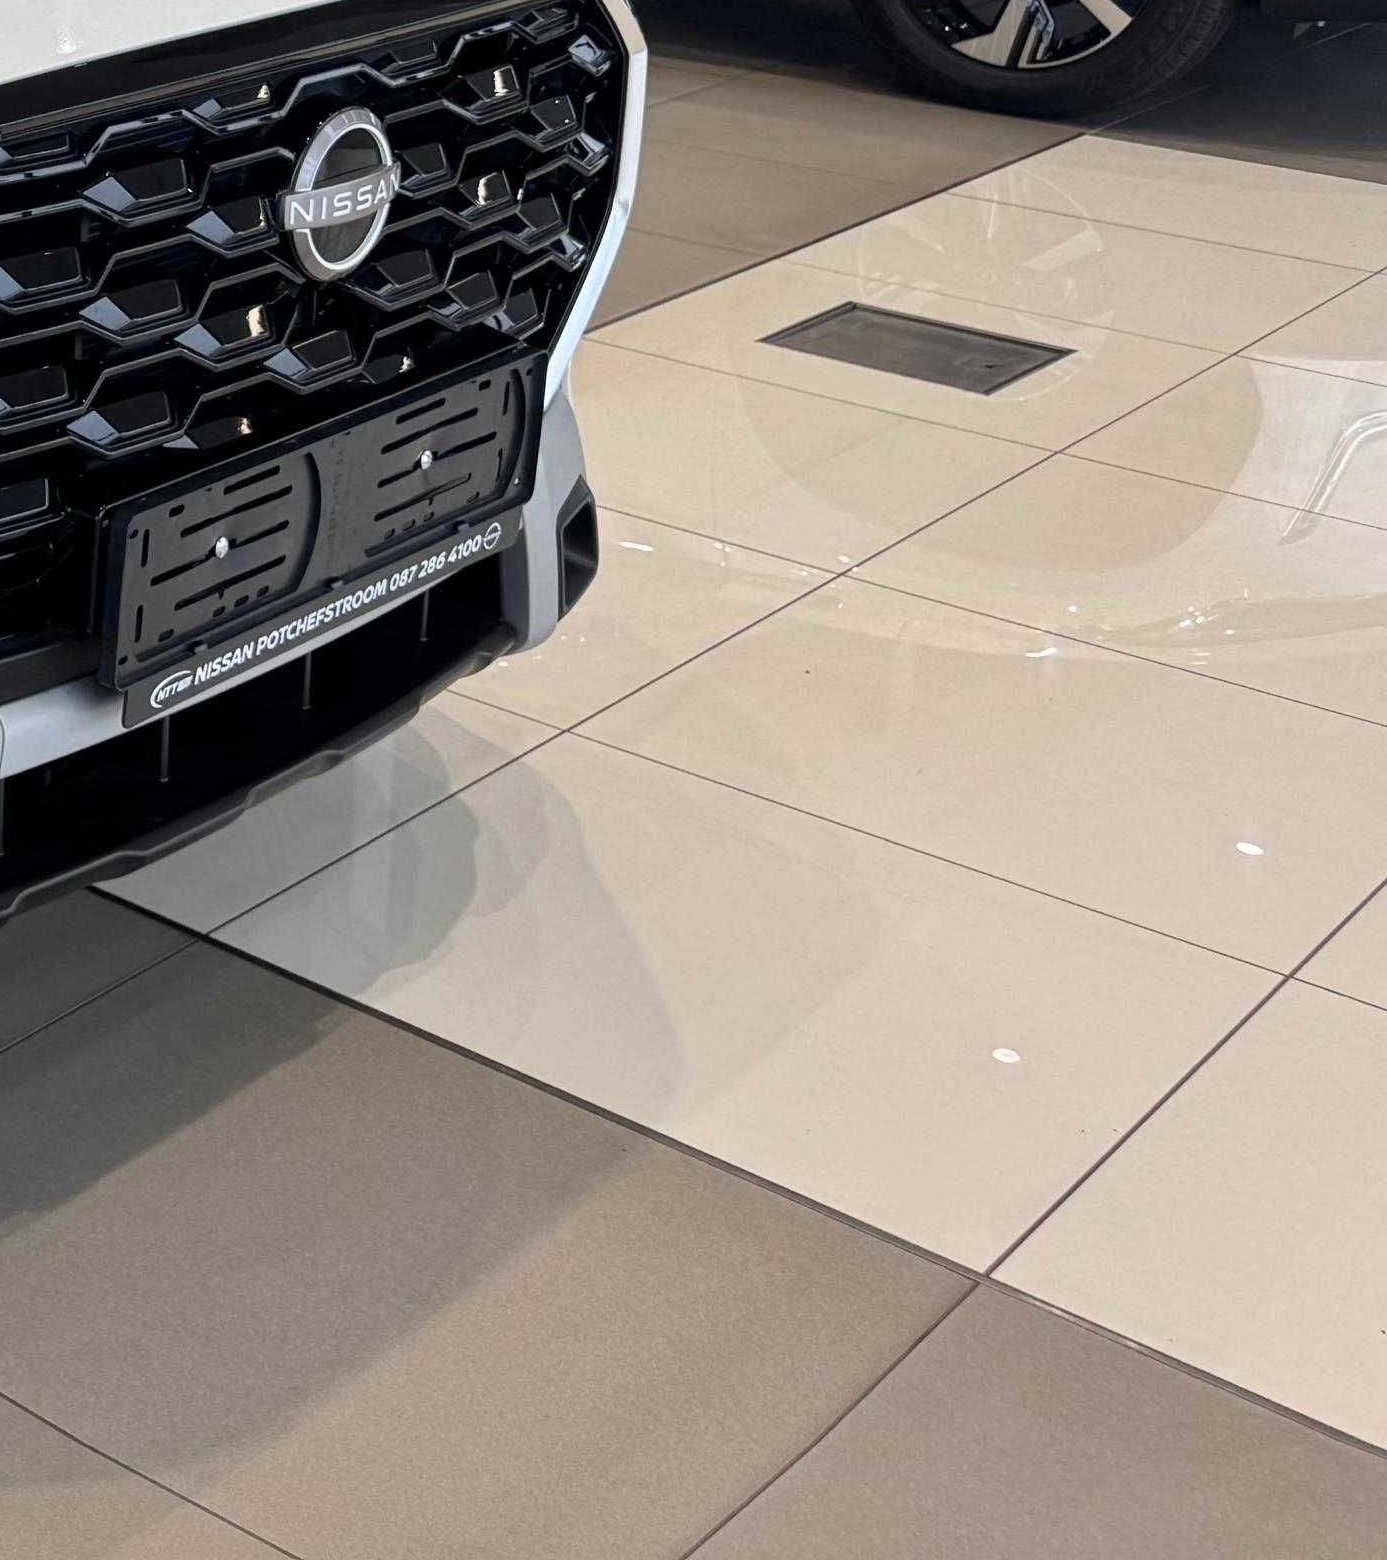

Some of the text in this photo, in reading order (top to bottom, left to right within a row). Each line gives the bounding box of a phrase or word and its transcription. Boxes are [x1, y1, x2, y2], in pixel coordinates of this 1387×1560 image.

[289, 173, 400, 225] NISSAN
[194, 643, 254, 685] NISSAN
[256, 578, 387, 656] POTCHEFSTROOM
[389, 567, 418, 592] 087
[417, 551, 445, 577] 286
[447, 535, 482, 562] 4100
